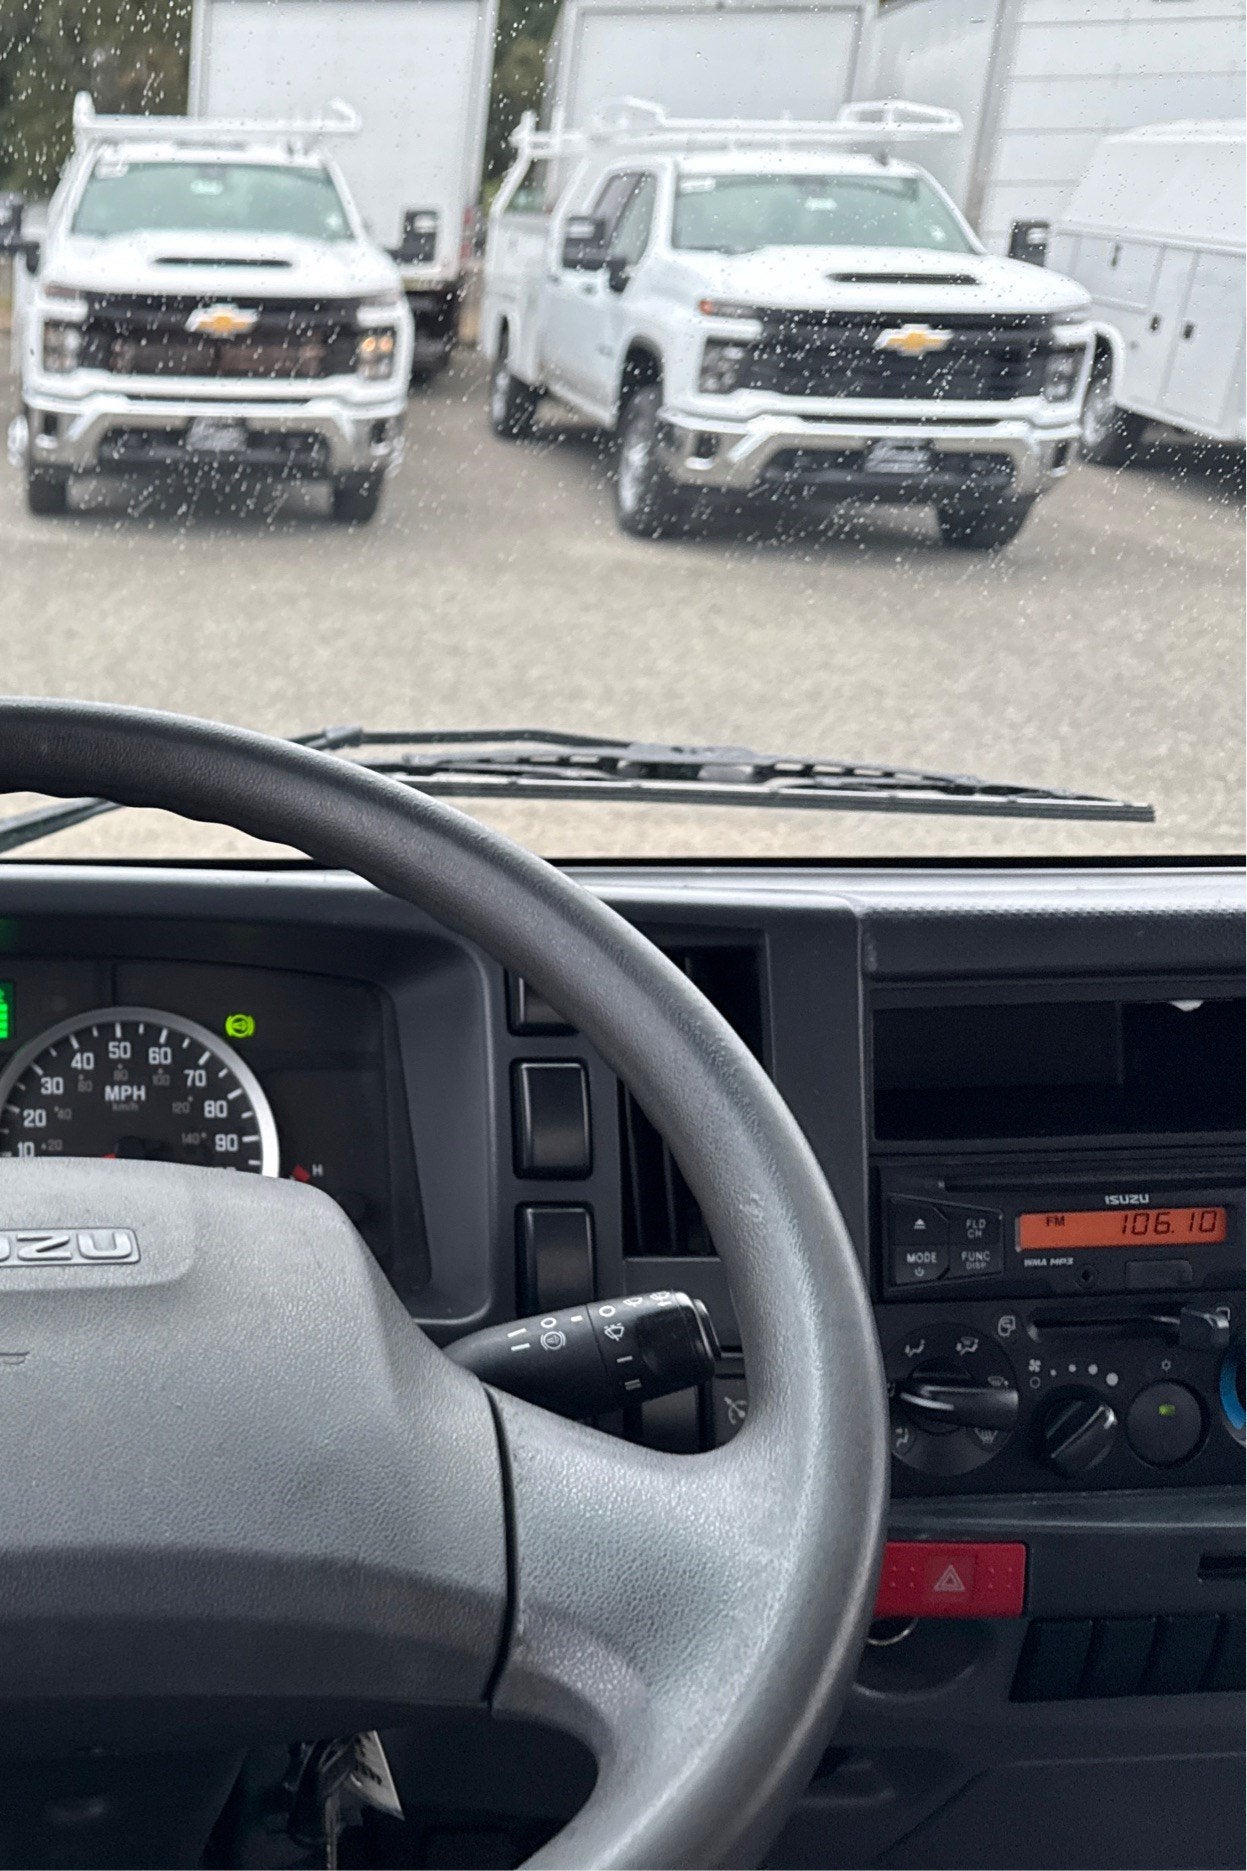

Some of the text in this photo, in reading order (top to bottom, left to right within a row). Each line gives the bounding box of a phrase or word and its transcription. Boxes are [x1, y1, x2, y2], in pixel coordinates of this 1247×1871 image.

[107, 1041, 132, 1060] 50
[148, 1046, 172, 1065] 60
[70, 1052, 95, 1071] 40
[40, 1076, 64, 1096] 30
[183, 1068, 207, 1088] 70
[104, 1084, 146, 1102] MPH
[23, 1107, 47, 1128] 20
[203, 1099, 228, 1119] 80
[17, 1141, 35, 1158] 10
[214, 1133, 239, 1153] 90
[312, 1164, 323, 1177] H
[1104, 1194, 1150, 1206] ISUZU
[965, 1218, 987, 1230] FLD
[1046, 1209, 1218, 1236] FM 106.10
[966, 1229, 983, 1239] CH
[906, 1251, 938, 1264] MODE
[960, 1250, 991, 1262] FUNC
[1023, 1256, 1074, 1268] WMA MP3
[965, 1261, 987, 1270] DISP
